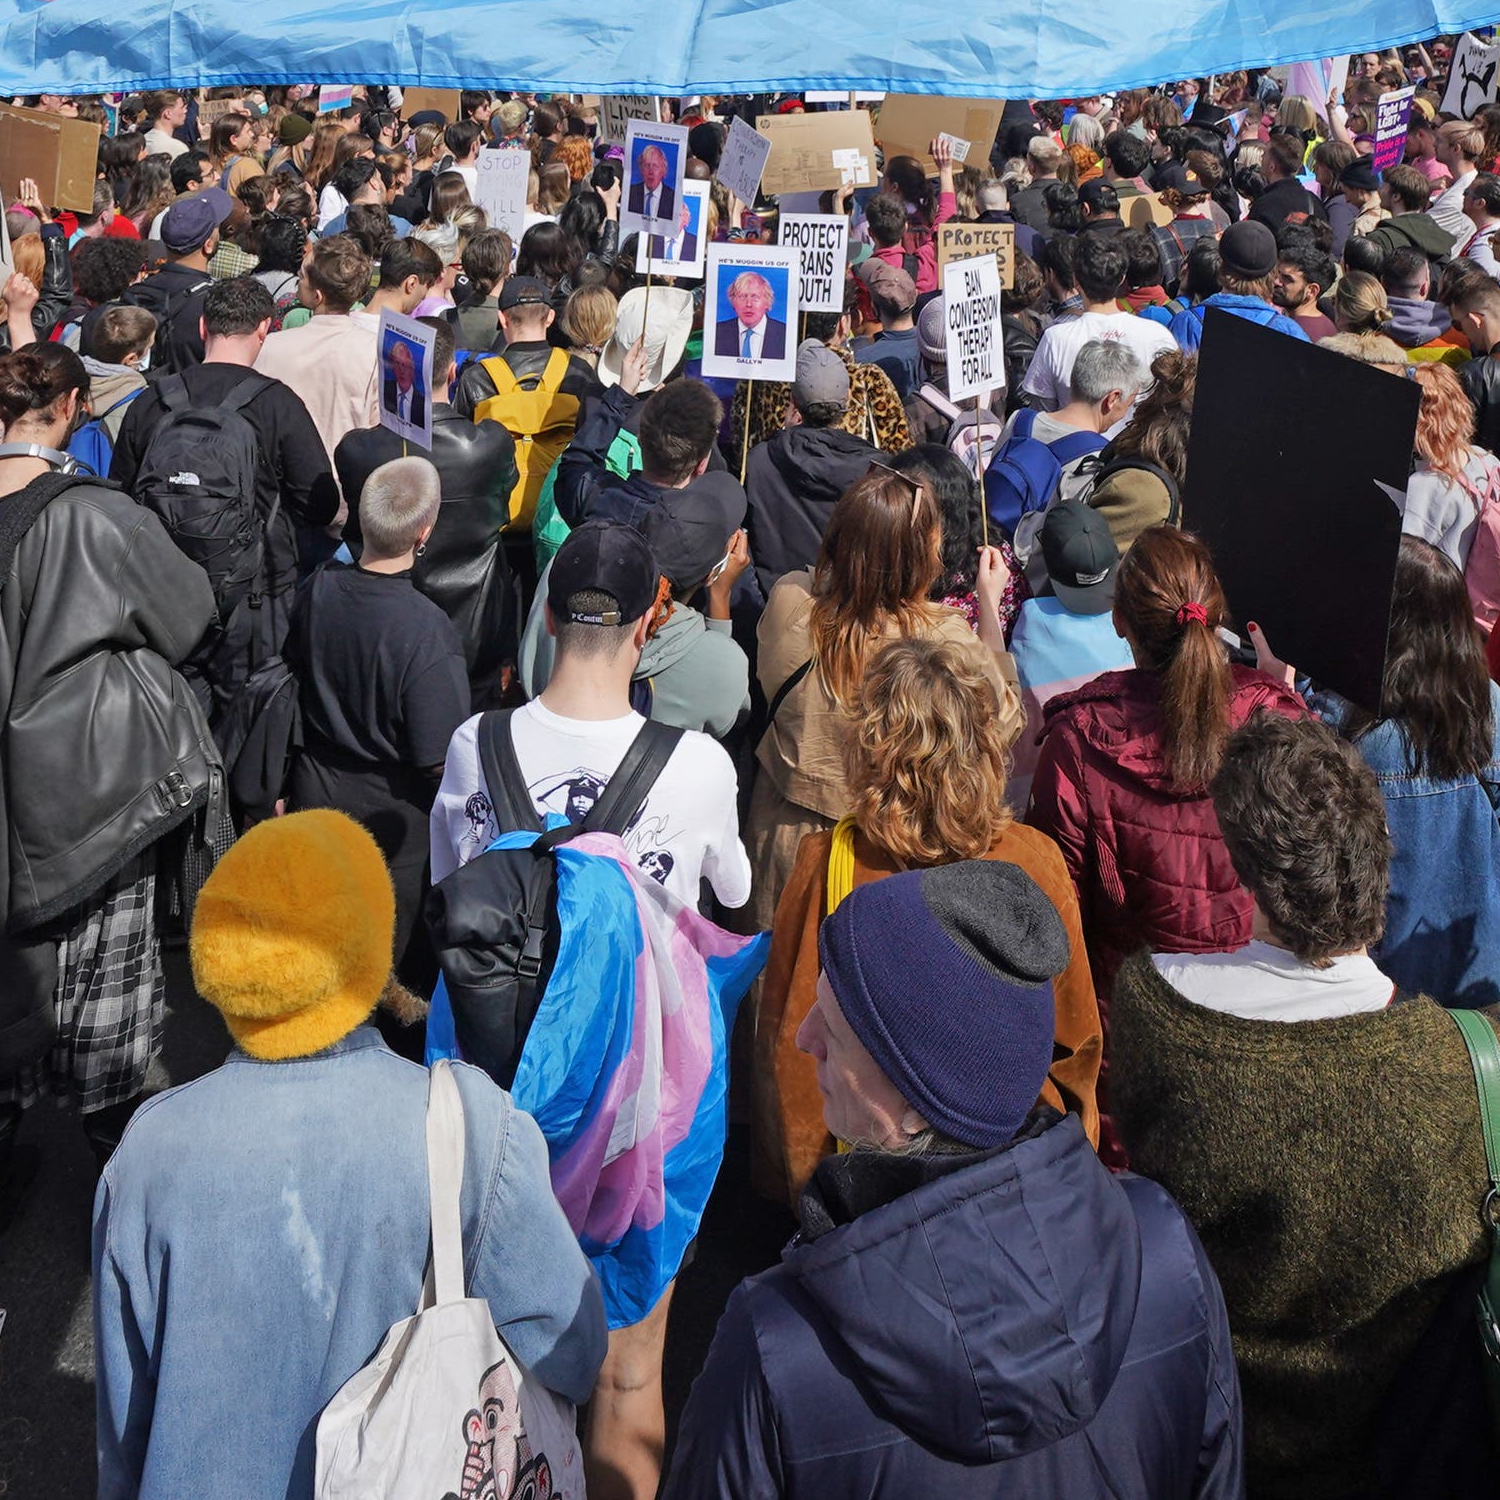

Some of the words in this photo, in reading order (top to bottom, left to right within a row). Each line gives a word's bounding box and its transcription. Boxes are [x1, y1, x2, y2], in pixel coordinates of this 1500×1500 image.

[610, 102, 651, 120] LIVES
[1378, 102, 1398, 116] Fight
[1399, 100, 1409, 110] for
[1378, 114, 1401, 129] LGBT+
[1377, 123, 1408, 141] liberation
[1375, 139, 1394, 152] Pride
[483, 156, 521, 171] STOP
[475, 199, 516, 214] KILL
[783, 222, 844, 249] PROTECT
[943, 229, 1014, 246] PROTECT
[800, 251, 833, 276] RANS
[799, 278, 831, 303] OUTH
[964, 268, 982, 298] BAN
[950, 294, 998, 329] CONVERSION
[957, 324, 993, 358] THERAPY
[962, 357, 979, 386] FOR
[979, 355, 992, 381] ALL
